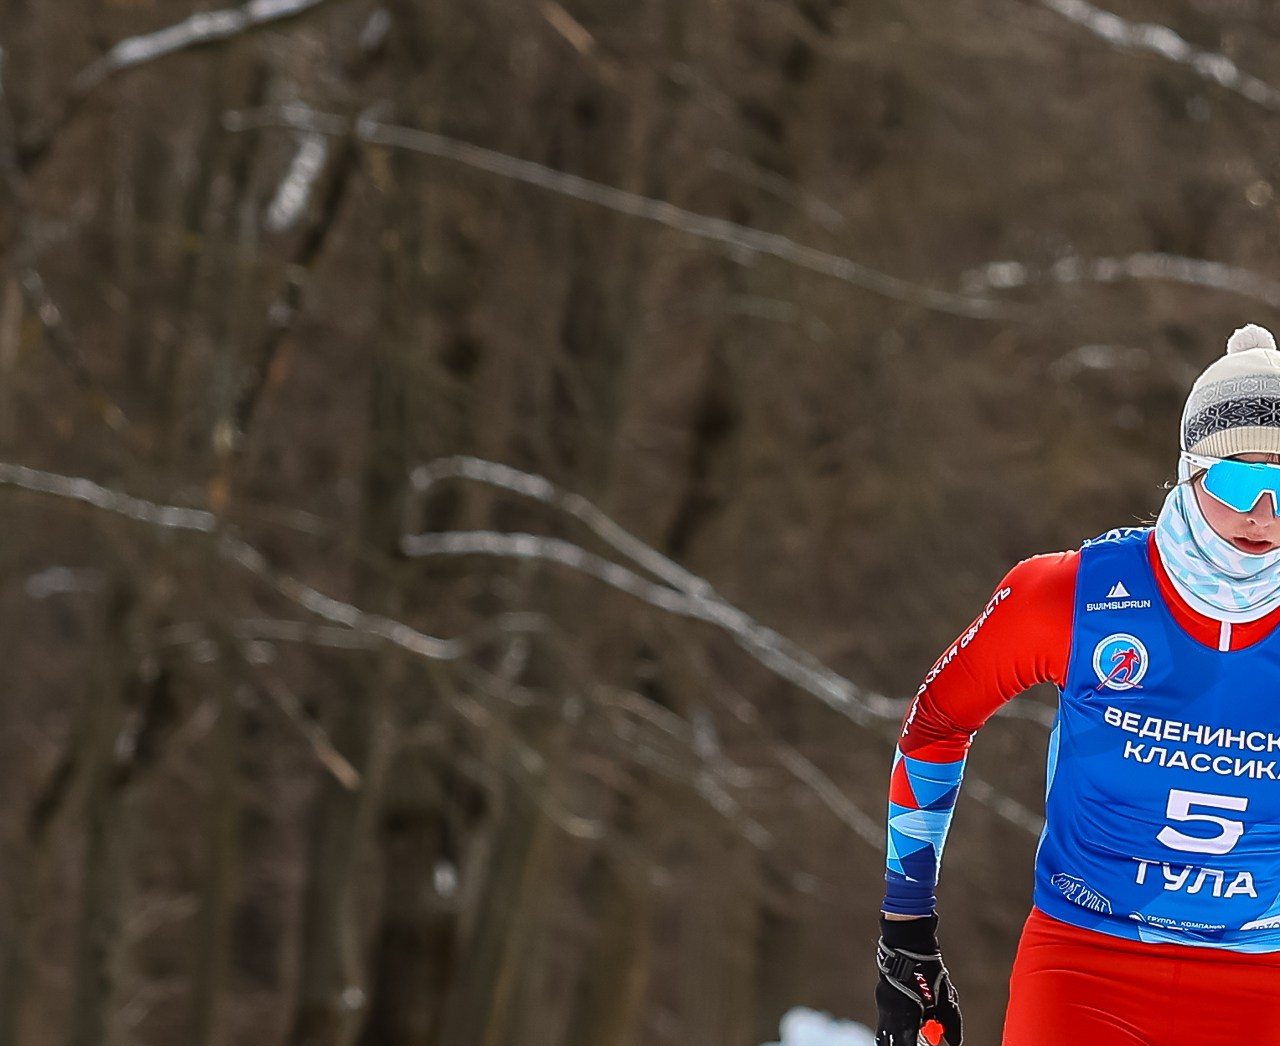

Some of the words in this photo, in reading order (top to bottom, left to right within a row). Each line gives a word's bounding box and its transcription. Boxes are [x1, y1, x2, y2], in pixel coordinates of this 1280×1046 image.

[1086, 599, 1151, 612] SWIMSUPRUN
[1155, 788, 1249, 855] 5
[1132, 856, 1258, 898] ТУЛА
[1147, 914, 1177, 926] ГРУППА
